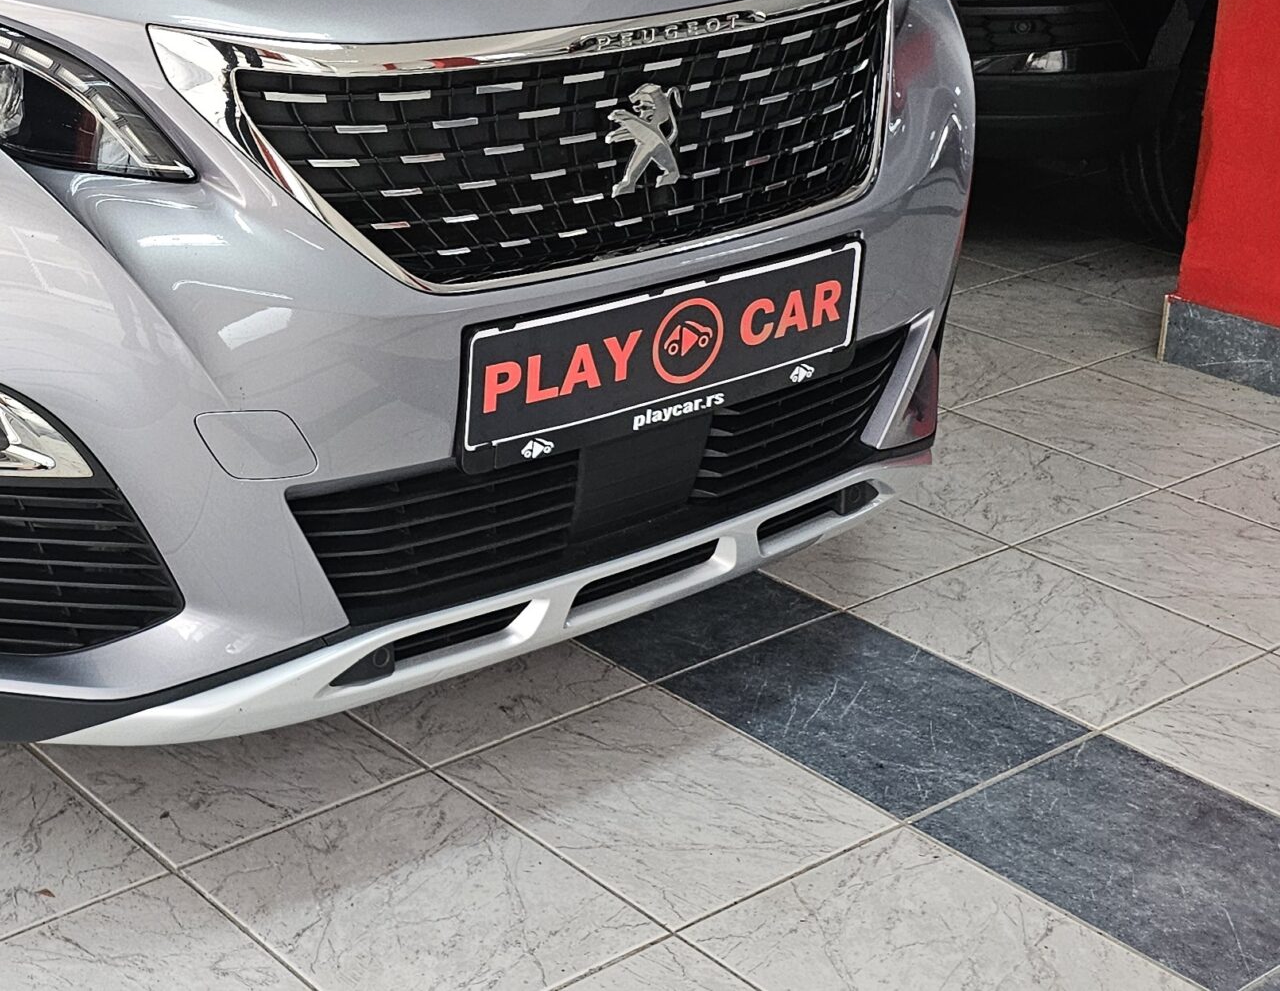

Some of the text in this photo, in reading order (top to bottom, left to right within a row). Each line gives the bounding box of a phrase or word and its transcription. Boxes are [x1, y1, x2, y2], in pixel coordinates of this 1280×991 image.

[597, 14, 740, 51] PEUGEOT
[482, 279, 843, 414] PLAY CAR
[632, 392, 725, 431] playcar.rs
